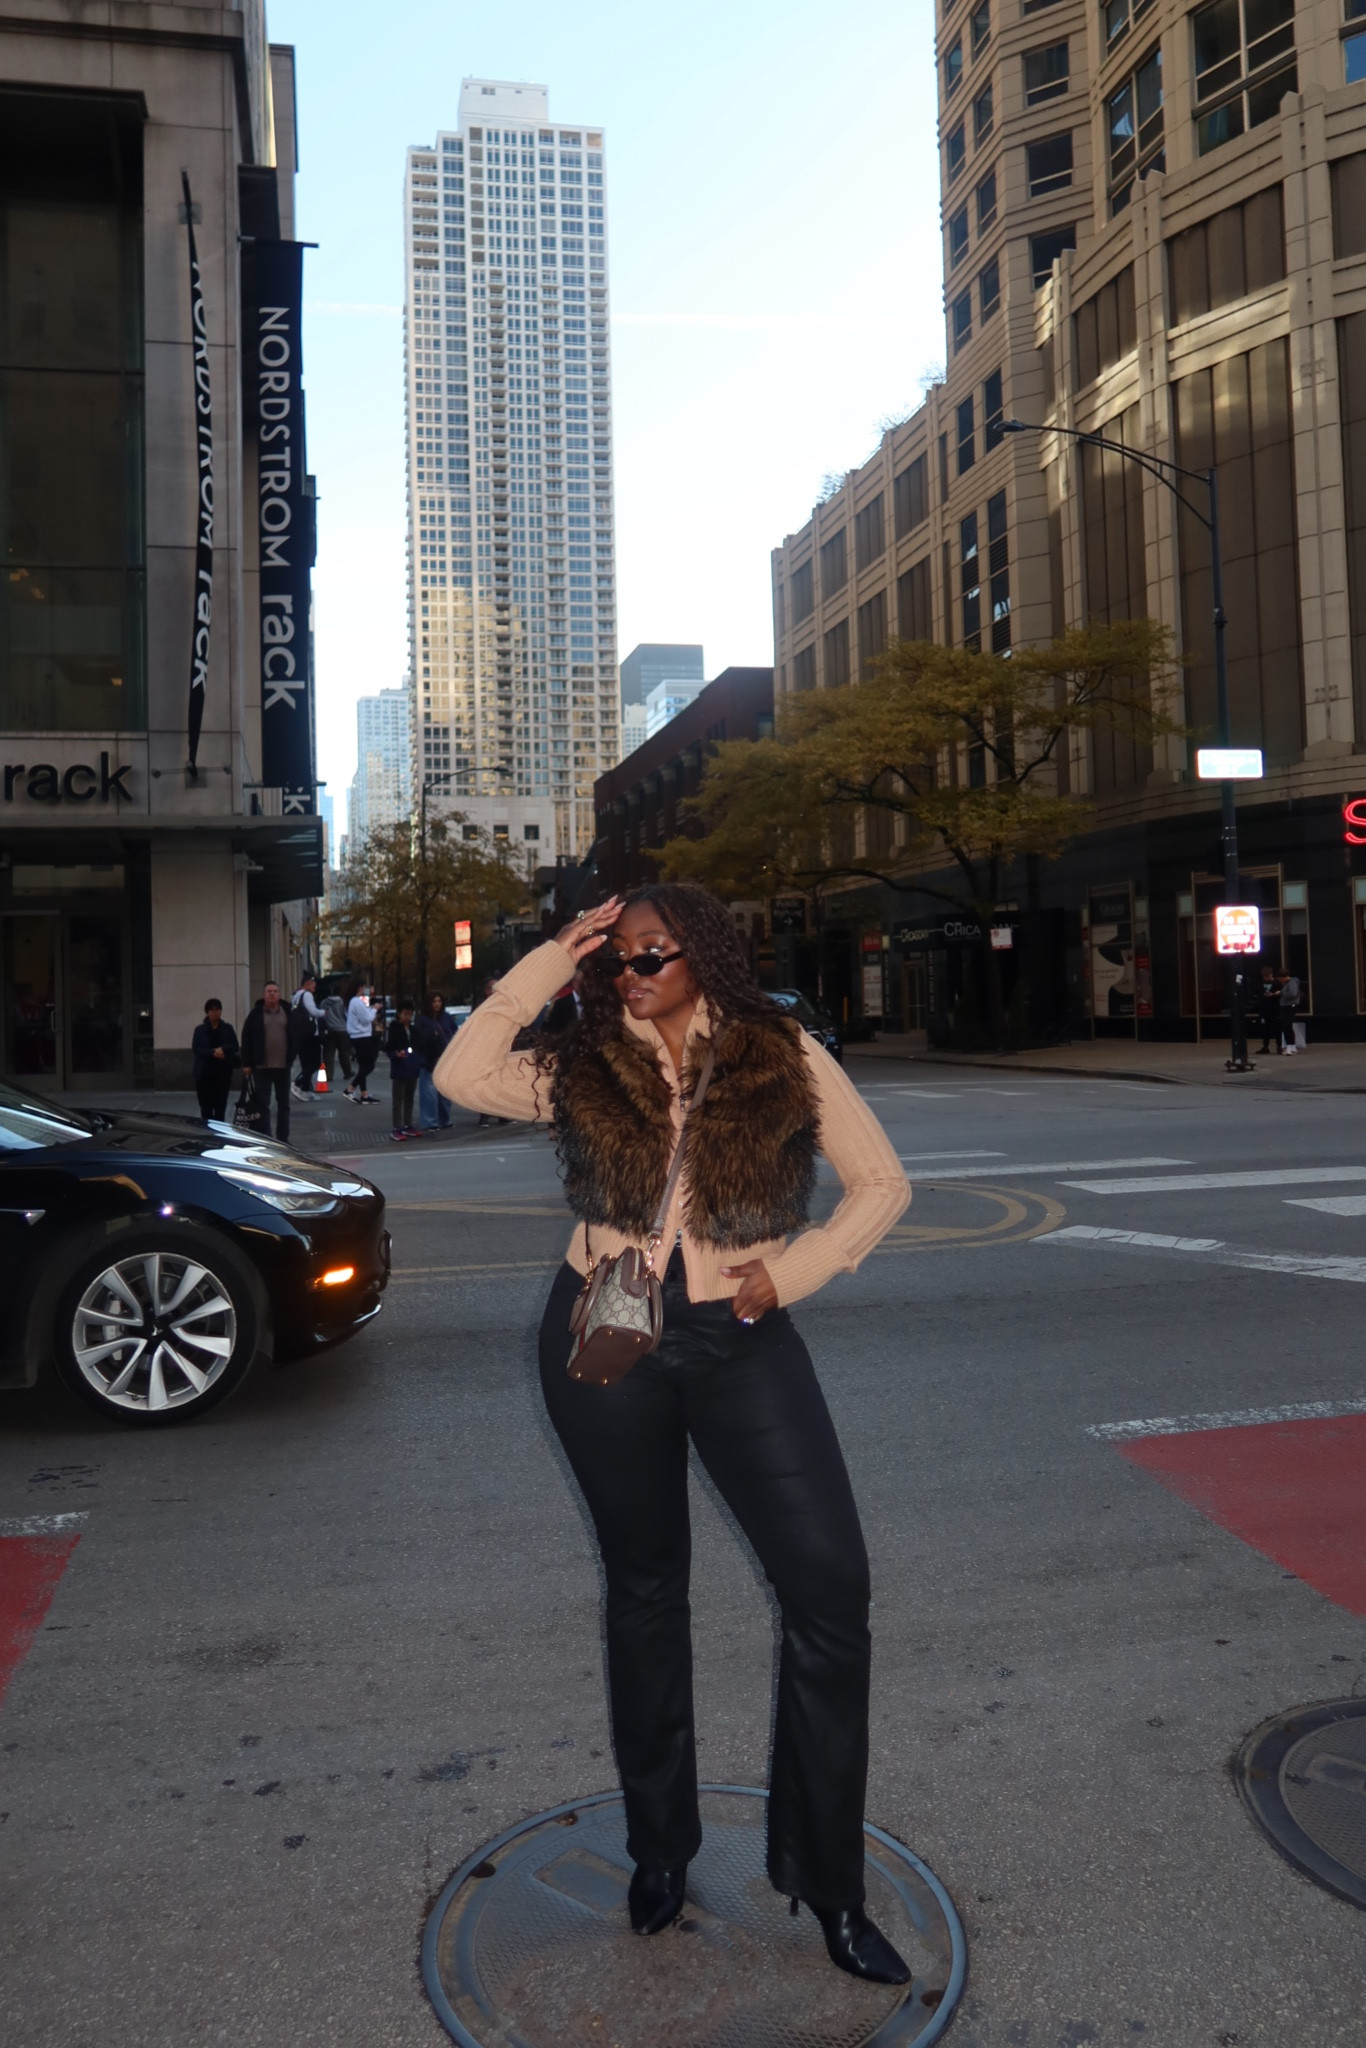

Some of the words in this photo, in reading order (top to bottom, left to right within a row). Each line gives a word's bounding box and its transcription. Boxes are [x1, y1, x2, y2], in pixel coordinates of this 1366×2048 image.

[258, 306, 292, 567] NORDSTROM
[192, 569, 213, 689] rack
[261, 594, 306, 710] rack
[4, 751, 133, 802] rack
